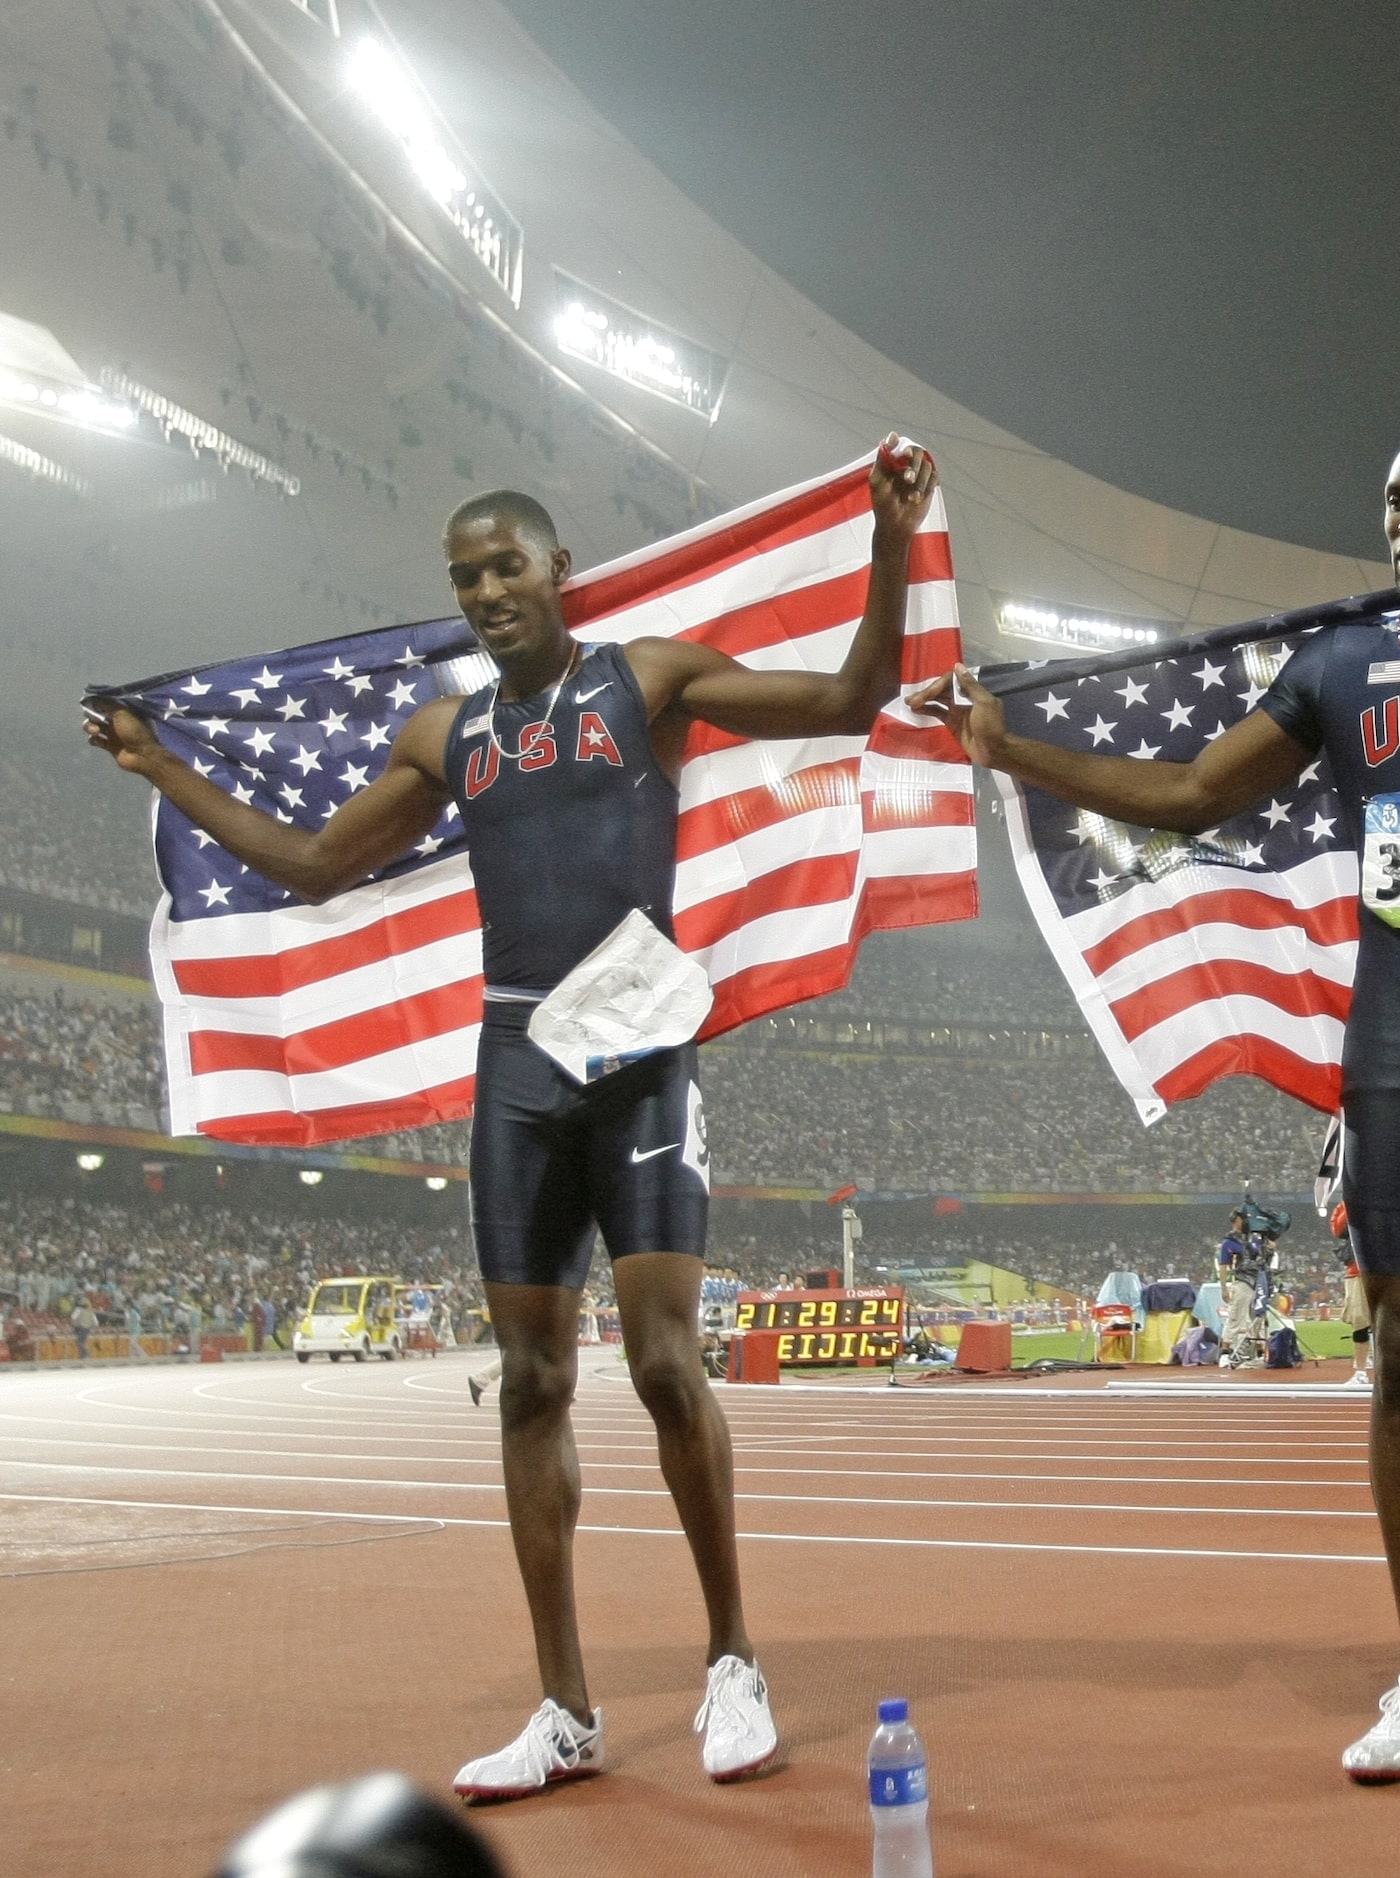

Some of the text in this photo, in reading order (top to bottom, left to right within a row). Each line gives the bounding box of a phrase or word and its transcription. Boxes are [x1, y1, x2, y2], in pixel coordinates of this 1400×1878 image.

[464, 711, 624, 801] USA
[856, 1288, 888, 1298] OMEGA
[737, 1299, 899, 1329] 21:29:24
